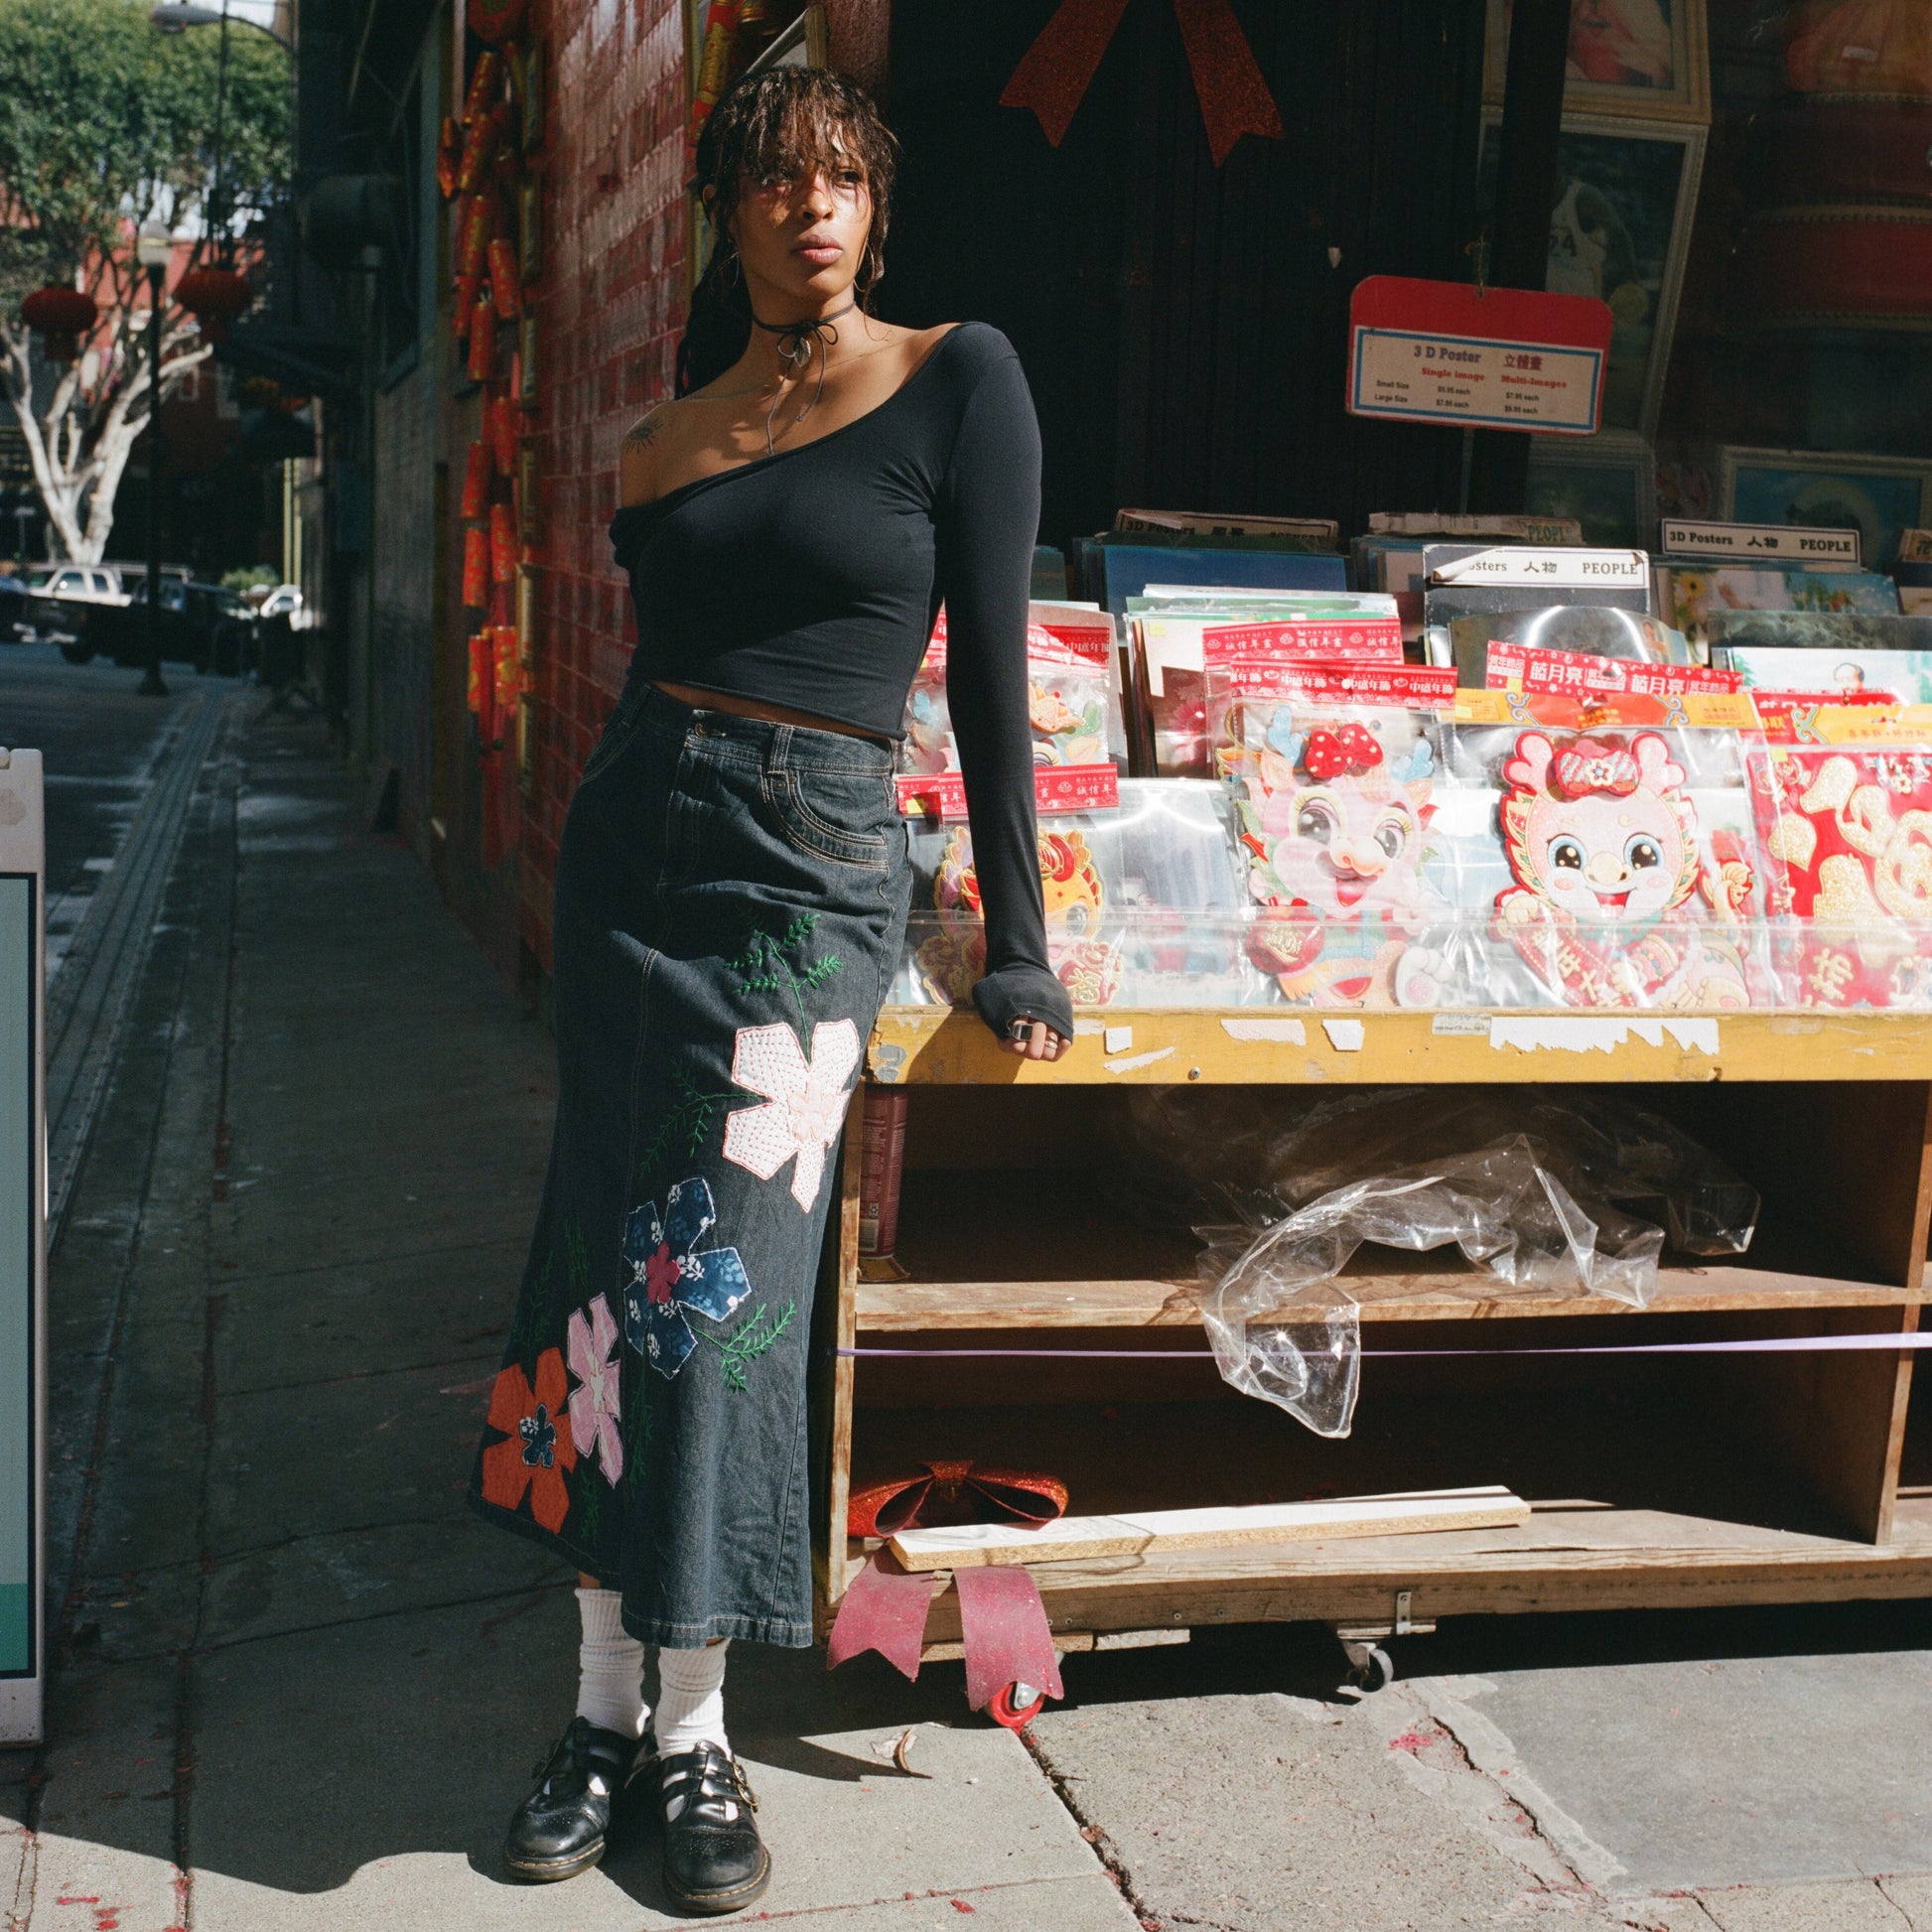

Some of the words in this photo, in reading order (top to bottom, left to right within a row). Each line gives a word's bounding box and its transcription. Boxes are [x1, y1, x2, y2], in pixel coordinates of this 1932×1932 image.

[1414, 345, 1422, 357] 3
[1426, 345, 1436, 358] D
[1440, 347, 1482, 363] Poster
[1422, 366, 1452, 378] Single
[1376, 379, 1395, 388] Small
[1500, 374, 1567, 389] Multi-Images
[1374, 393, 1393, 402] Large
[1395, 394, 1408, 403] Size
[1669, 530, 1686, 542] 3D
[1689, 532, 1733, 545] Posters
[1747, 536, 1779, 549] 人物
[1800, 539, 1852, 552] PEOPLE
[1524, 561, 1558, 574] 人物
[1583, 562, 1638, 575] PEOPLE
